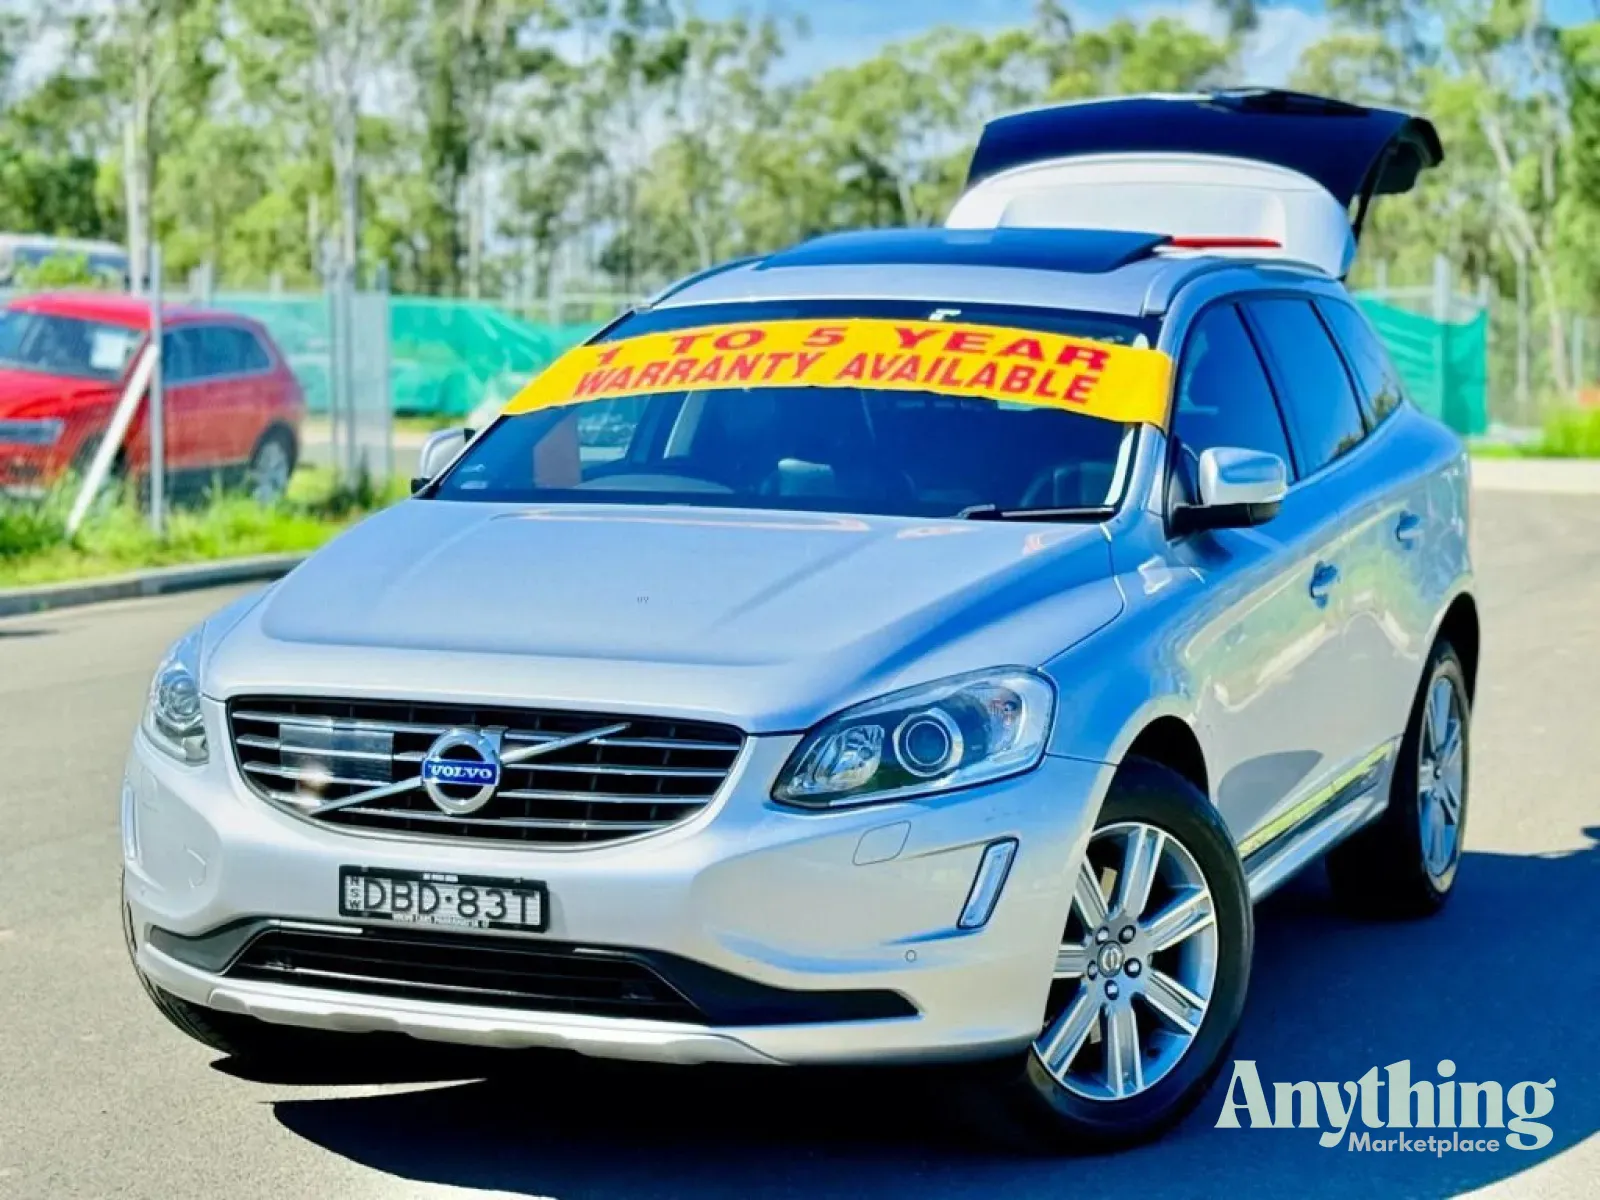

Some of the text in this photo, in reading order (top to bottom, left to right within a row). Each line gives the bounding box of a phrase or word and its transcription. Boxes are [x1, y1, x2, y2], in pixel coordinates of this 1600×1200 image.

[597, 326, 1112, 372] 1 TO 5 YEAR
[573, 351, 1100, 405] WARRANTY AVAILABLE
[428, 764, 493, 779] VOLVO
